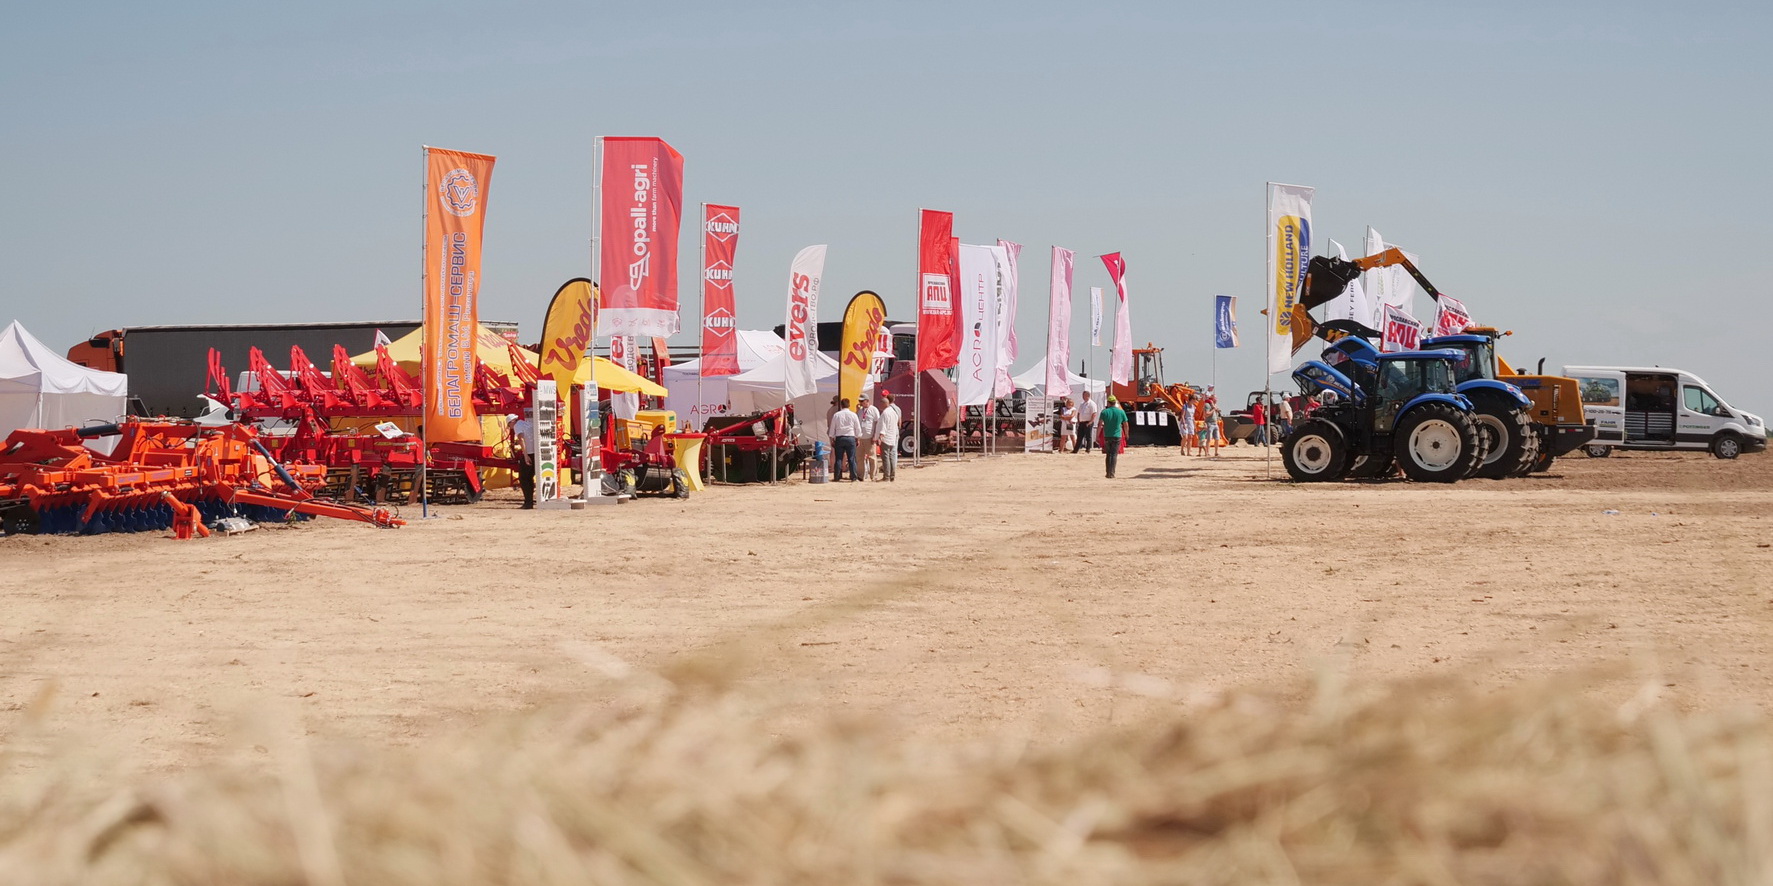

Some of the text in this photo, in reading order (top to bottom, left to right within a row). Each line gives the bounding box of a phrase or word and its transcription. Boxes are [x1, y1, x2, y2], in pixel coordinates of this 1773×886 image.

[651, 157, 659, 187] machinery
[707, 222, 737, 234] KUHN
[1284, 224, 1295, 309] NEW HOLLAND
[543, 298, 599, 371] Vredo
[788, 272, 810, 361] evers
[843, 307, 882, 370] Vredo
[1387, 320, 1418, 350] АПЦ
